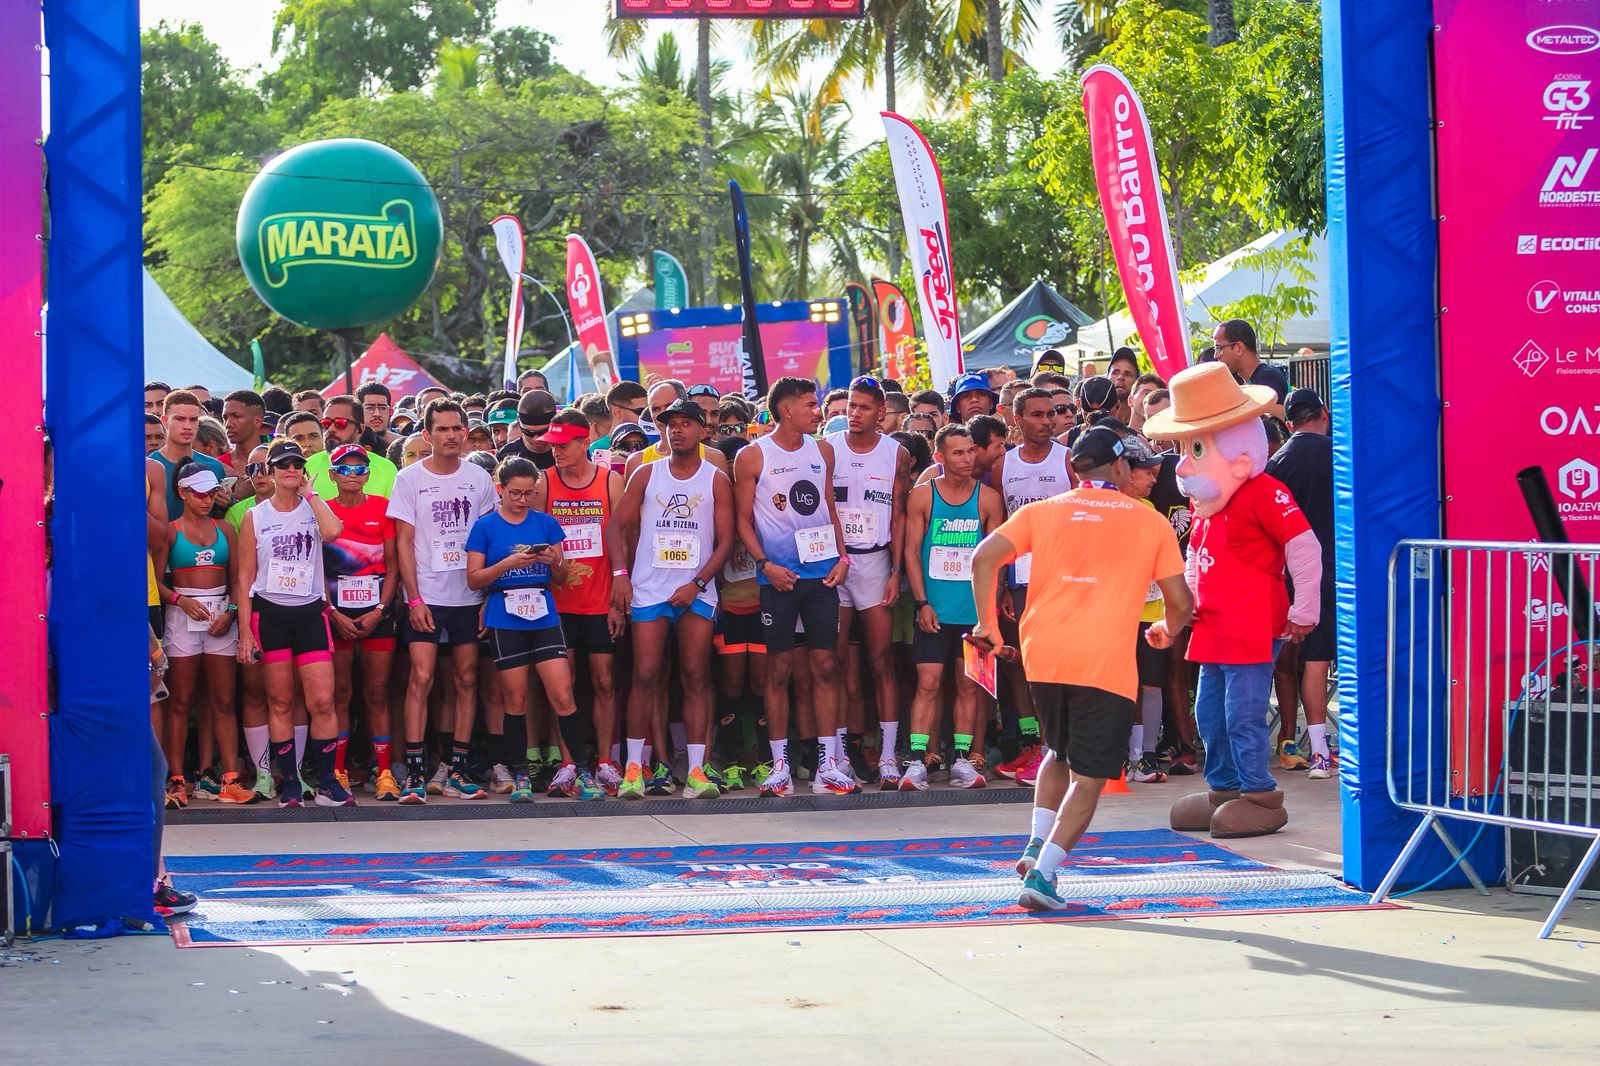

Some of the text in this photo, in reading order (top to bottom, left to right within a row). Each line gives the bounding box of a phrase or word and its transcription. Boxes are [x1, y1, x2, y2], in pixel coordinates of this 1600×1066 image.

[1536, 35, 1595, 46] METALTEC
[1543, 80, 1593, 111] G3
[1113, 93, 1148, 227] Bairro
[1539, 191, 1600, 204] NORDESTE
[1556, 347, 1578, 363] Le
[431, 500, 456, 512] SUN
[433, 511, 454, 523] SET
[656, 519, 699, 530] ALAN BIZERRA
[845, 523, 864, 535] 584
[272, 534, 298, 548] SUN
[565, 540, 590, 551] 1118
[809, 541, 825, 553] 976
[273, 545, 297, 558] SET
[442, 551, 461, 563] 923
[664, 550, 687, 561] 1065
[943, 561, 962, 572] 888
[278, 576, 297, 588] 738
[345, 590, 369, 601] 1105
[517, 605, 536, 616] 874
[673, 861, 832, 873] TUDO
